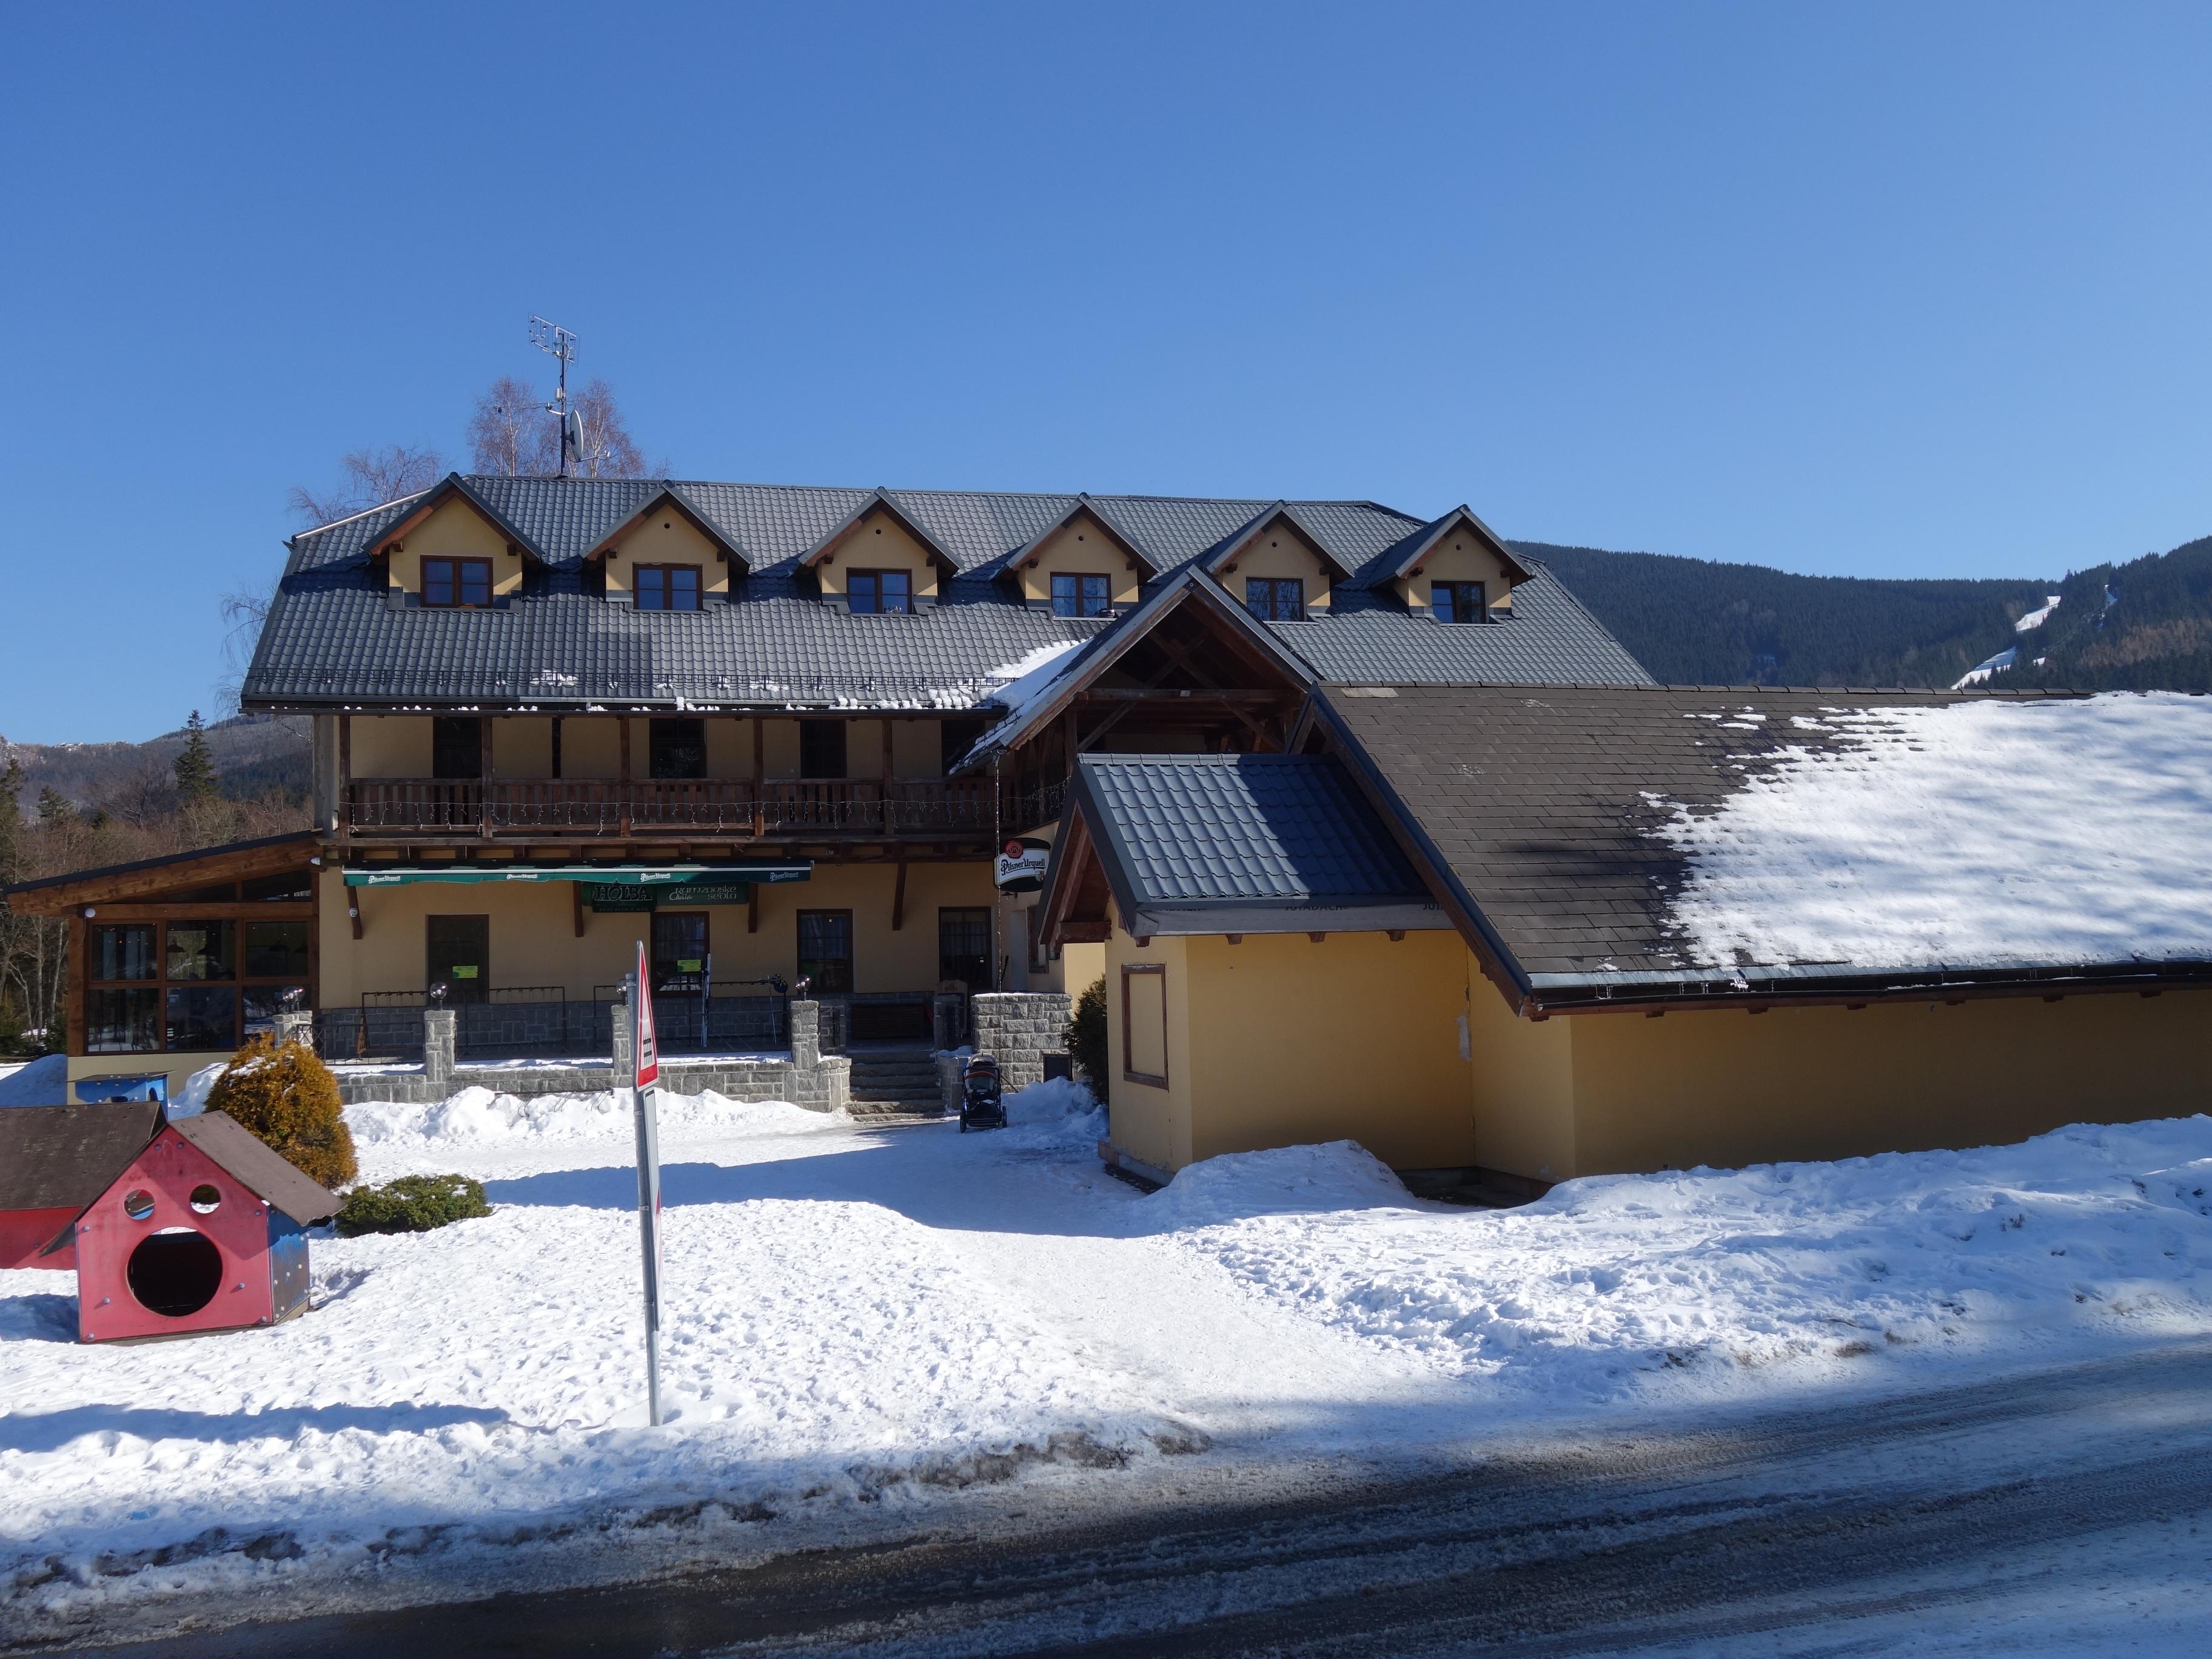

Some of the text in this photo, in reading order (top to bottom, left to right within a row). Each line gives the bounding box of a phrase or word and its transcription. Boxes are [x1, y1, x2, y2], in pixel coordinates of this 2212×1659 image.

[1001, 858, 1045, 876] Pilsner Urquell
[593, 885, 653, 902] HOLBA
